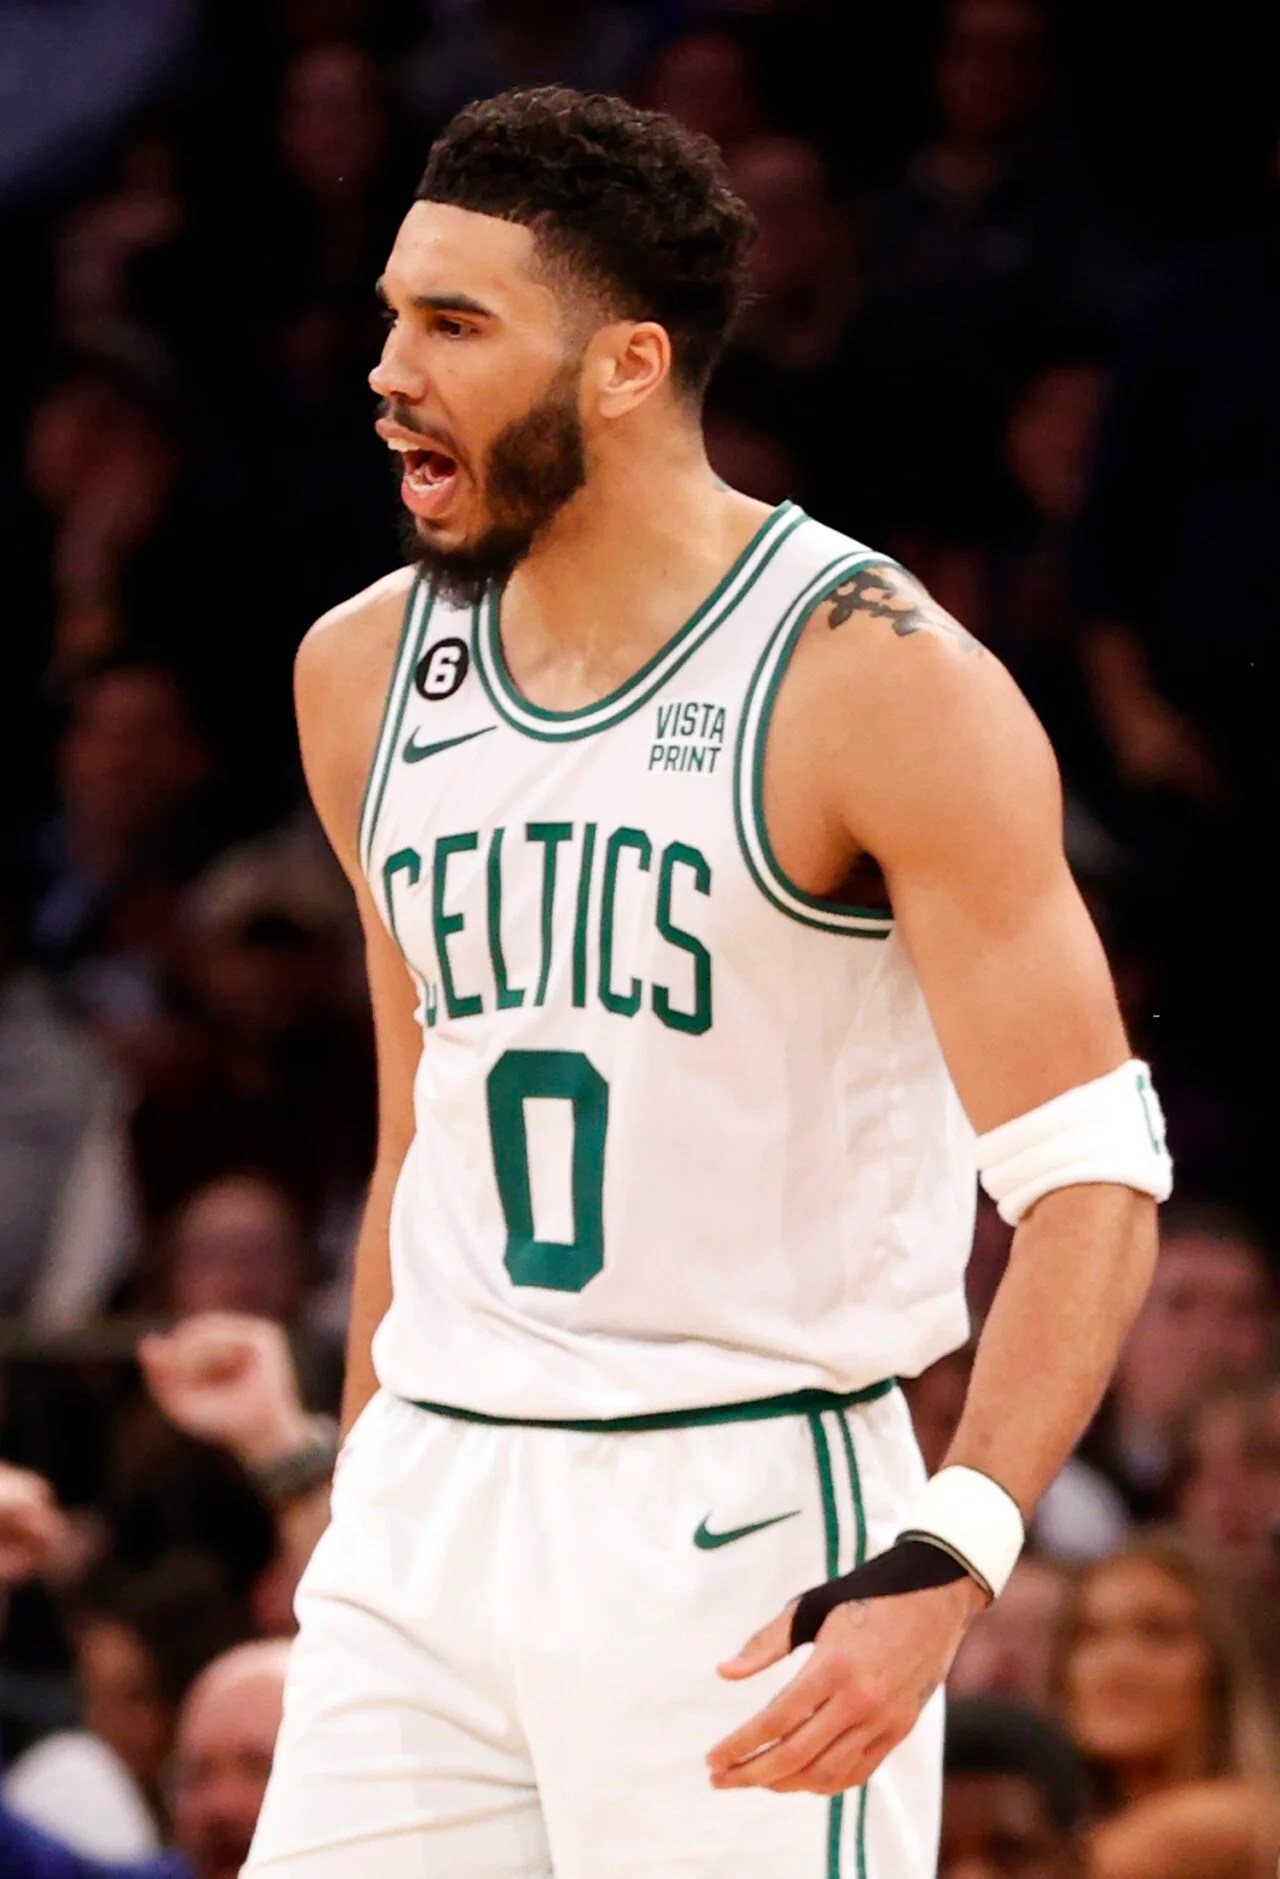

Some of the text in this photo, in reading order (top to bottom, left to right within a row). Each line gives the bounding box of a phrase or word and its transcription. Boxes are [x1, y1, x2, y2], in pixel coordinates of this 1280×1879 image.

[423, 645, 461, 695] 6
[656, 702, 726, 743] VISTA
[648, 744, 722, 773] PRINT
[383, 822, 712, 1036] CELTICS
[486, 1049, 609, 1292] 0
